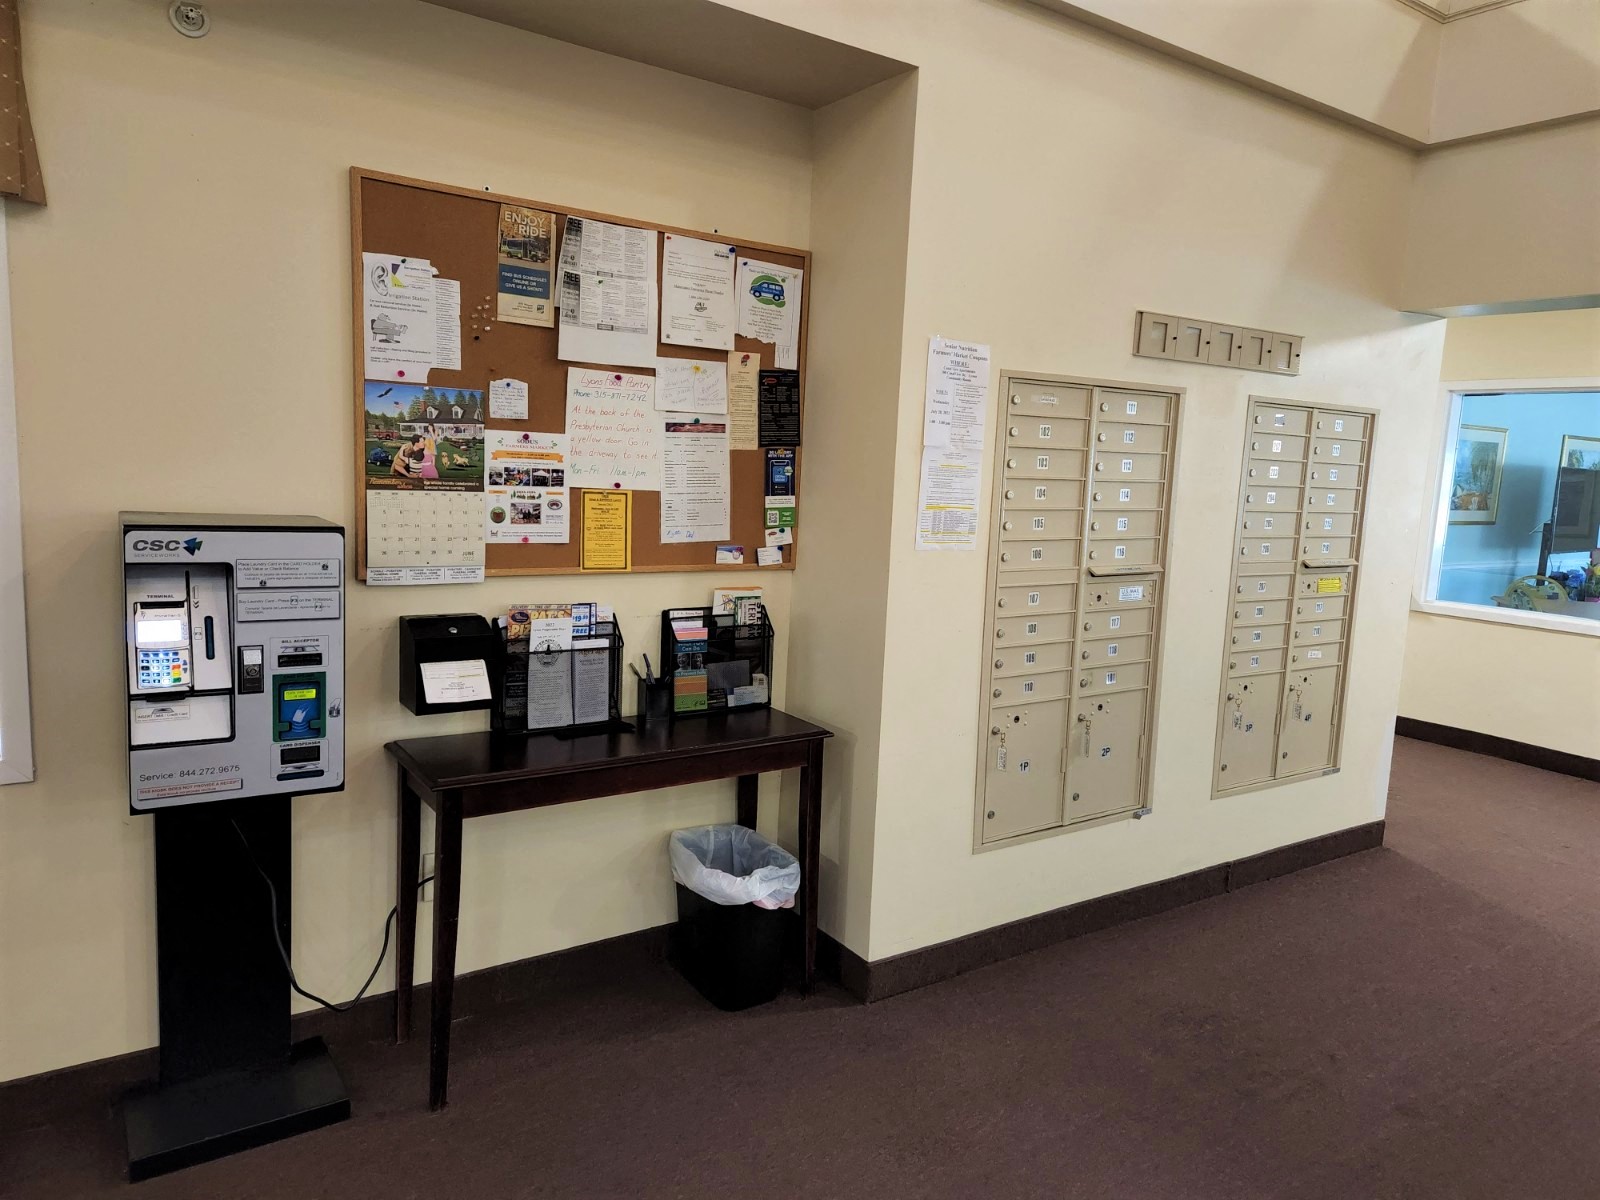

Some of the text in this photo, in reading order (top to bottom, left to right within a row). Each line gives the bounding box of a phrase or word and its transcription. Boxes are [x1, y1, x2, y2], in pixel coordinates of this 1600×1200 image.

[504, 211, 545, 227] ENJOY
[566, 217, 583, 226] FREE
[518, 224, 547, 238] RIDE
[563, 270, 580, 280] FREE
[580, 371, 652, 393] Lyons Food Pantry
[571, 404, 645, 418] At the back of the
[569, 419, 613, 433] Presbyterian
[615, 423, 640, 432] Church
[577, 434, 602, 444] yellow
[627, 437, 639, 447] Go
[569, 446, 582, 457] the
[588, 448, 618, 461] driveway
[623, 449, 632, 459] to
[132, 539, 181, 552] CSC
[1304, 713, 1312, 721] 4P
[1245, 723, 1253, 733] 3P
[1101, 747, 1111, 757] 2P
[139, 764, 241, 782] Service: 844.272.9675
[1019, 761, 1029, 772] 1P
